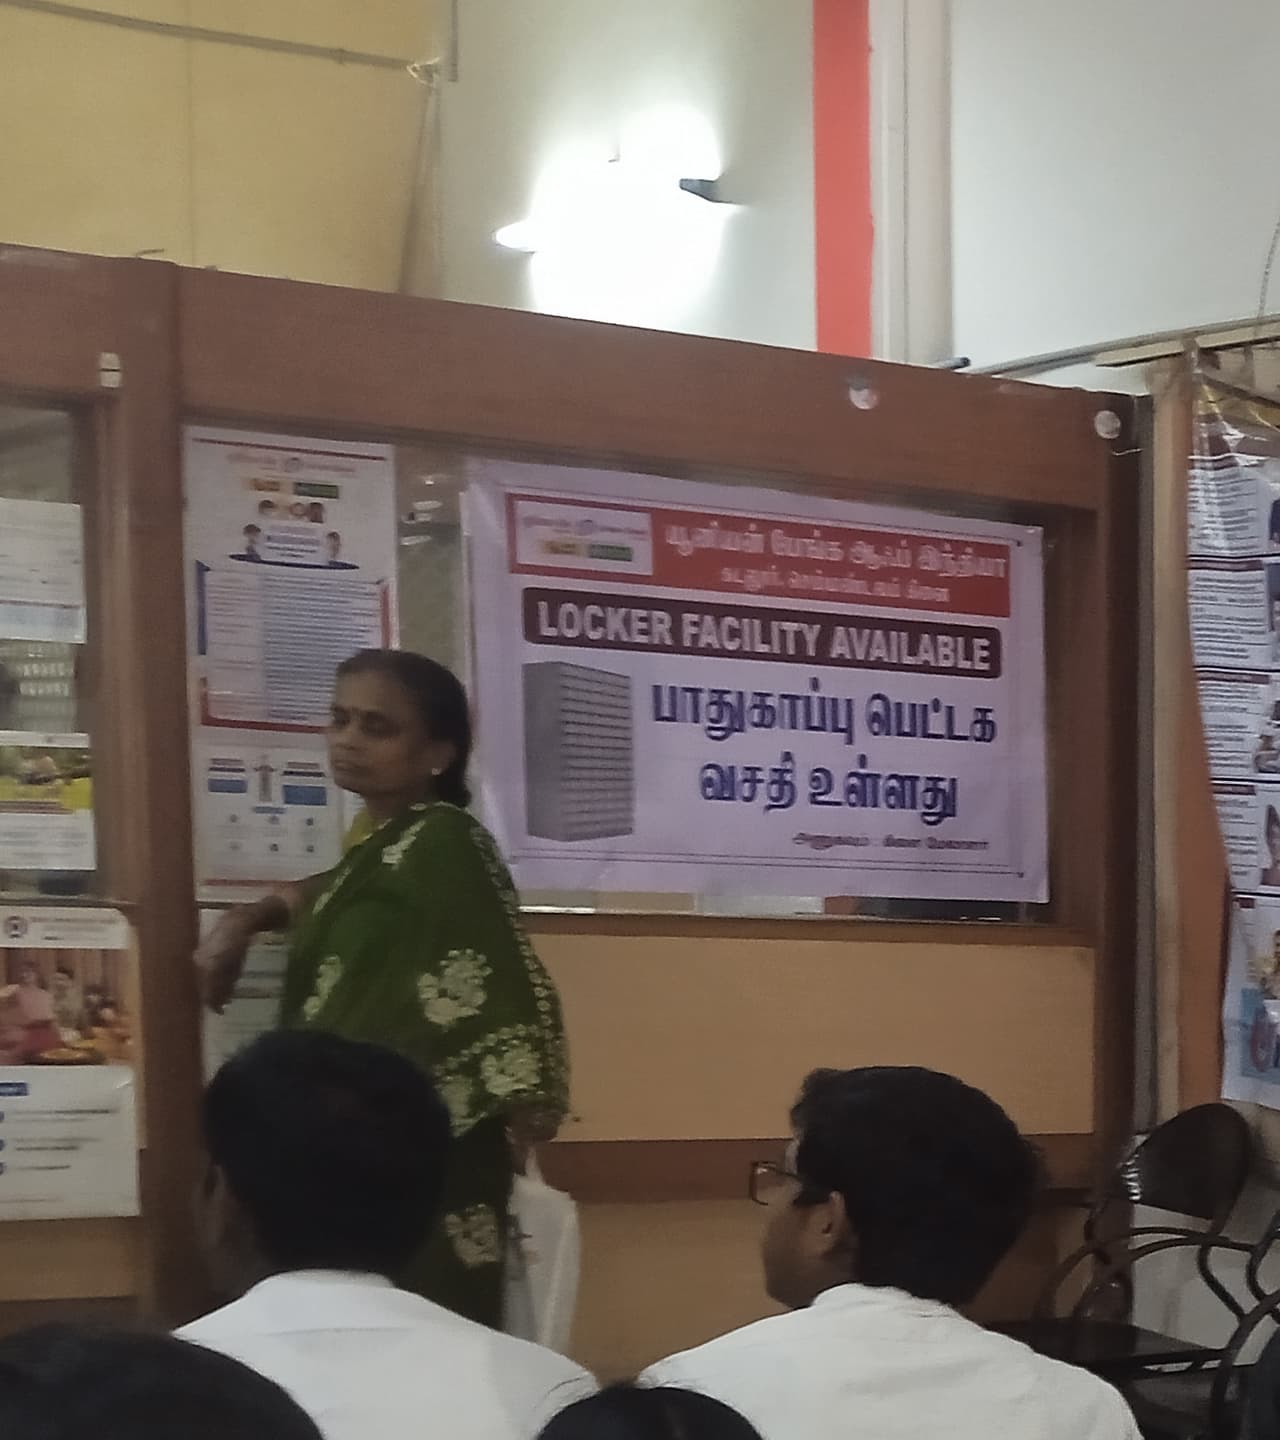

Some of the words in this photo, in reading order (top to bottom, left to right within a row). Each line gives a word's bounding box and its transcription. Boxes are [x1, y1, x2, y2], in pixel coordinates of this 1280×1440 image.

[538, 601, 673, 646] LOCKER
[681, 612, 822, 657] FACILITY
[830, 625, 990, 671] AVAILABLE
[651, 677, 855, 745] பாதுகாப்பு
[866, 691, 998, 744] பெட்டக
[701, 751, 799, 816] வசதி
[809, 753, 958, 826] உள்ளது
